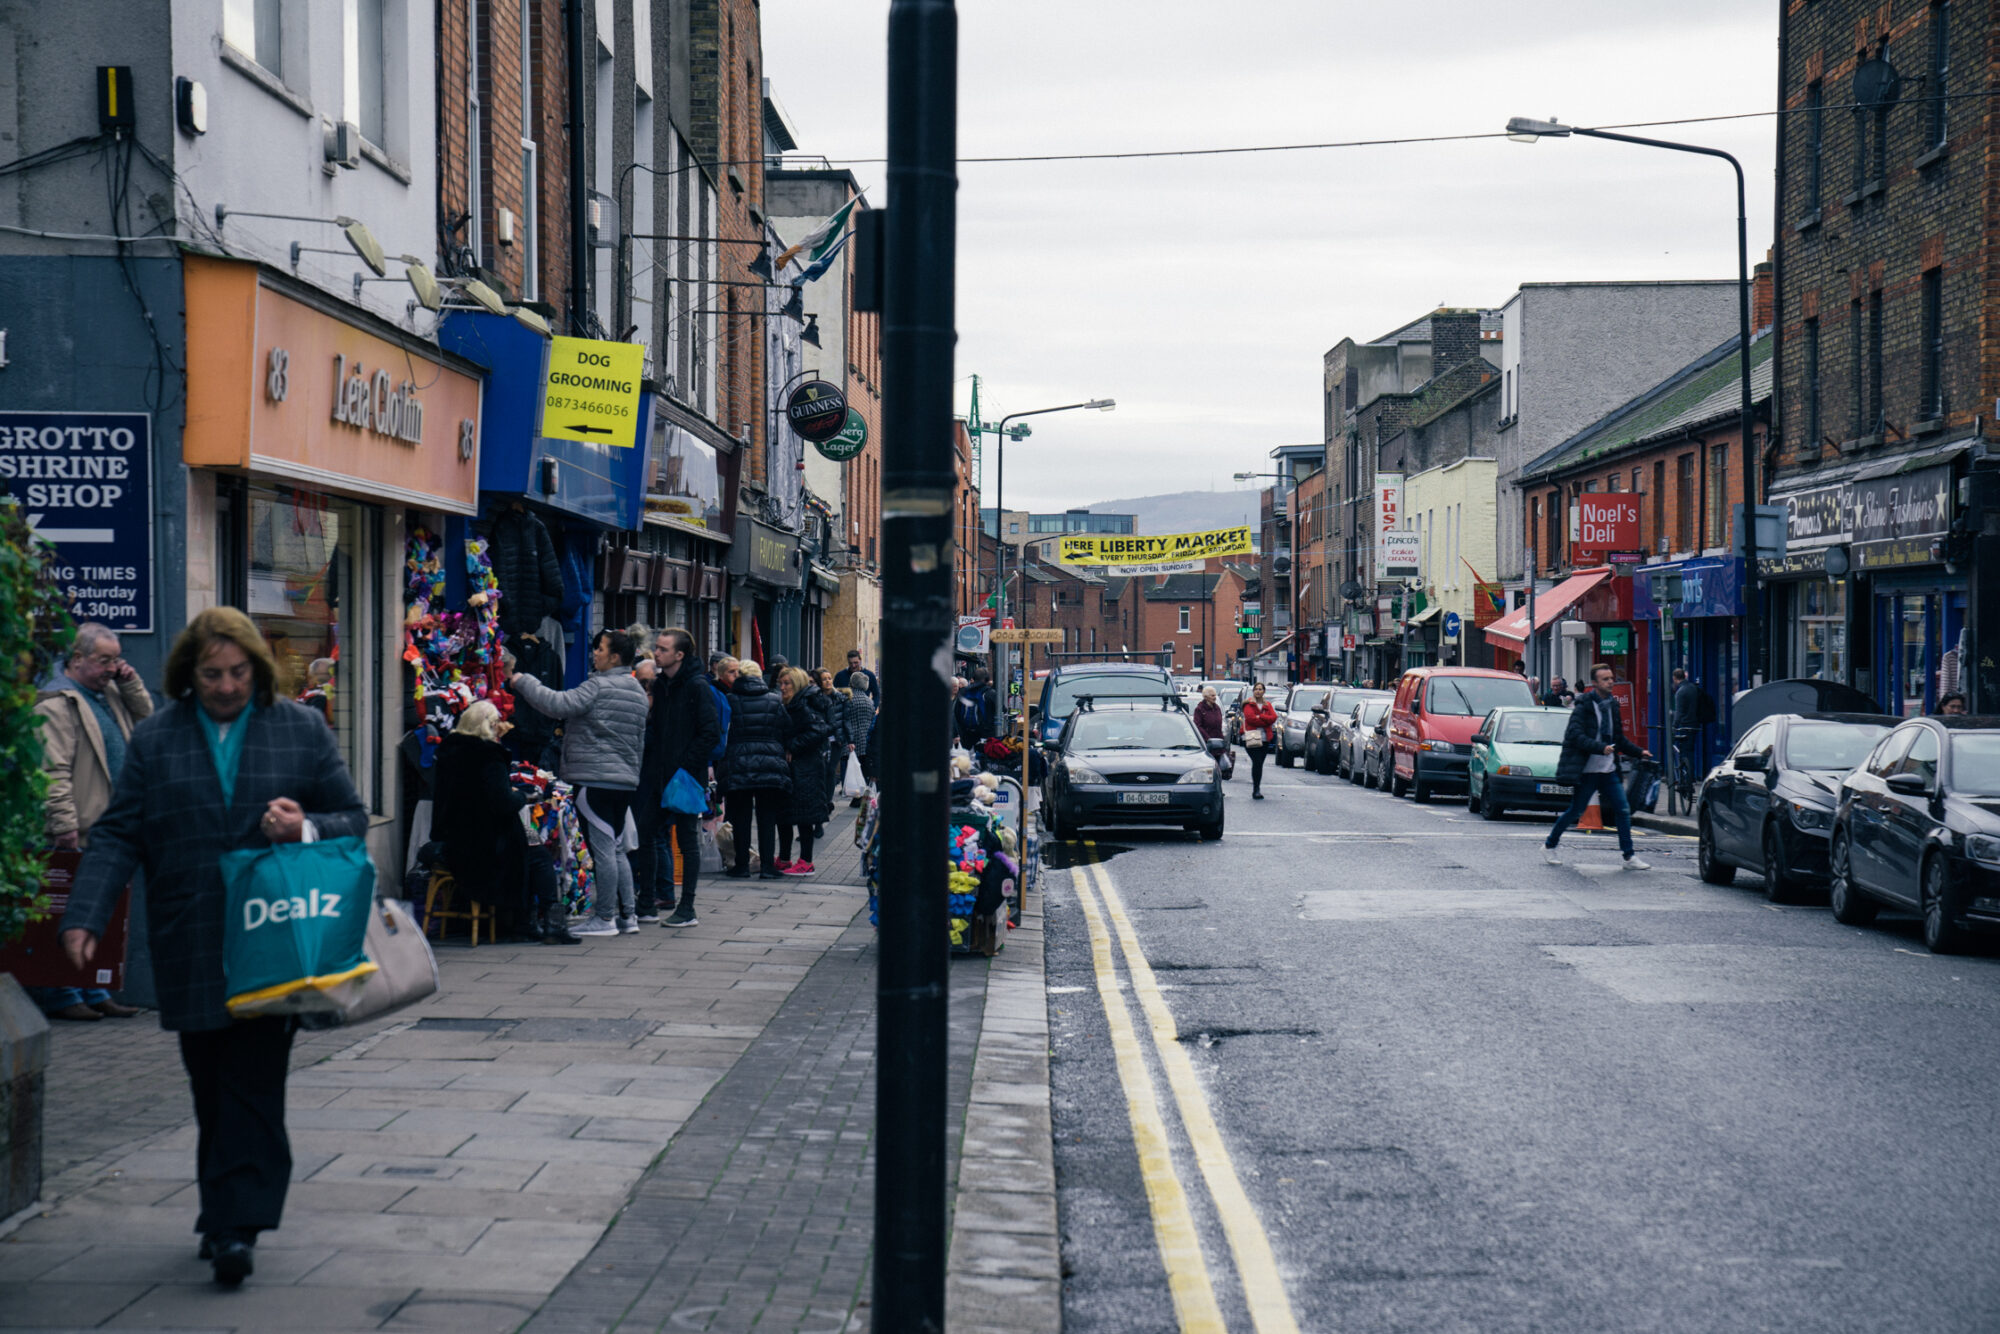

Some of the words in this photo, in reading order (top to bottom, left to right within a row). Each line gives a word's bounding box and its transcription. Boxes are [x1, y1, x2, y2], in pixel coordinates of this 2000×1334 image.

[577, 352, 611, 368] DOG
[269, 347, 289, 402] 83
[550, 372, 632, 394] GROOMING
[546, 396, 629, 418] 0873466056
[790, 398, 843, 419] GUINNESS
[823, 443, 856, 455] Lager
[0, 455, 130, 480] SHRINE
[27, 484, 123, 508] SHOP
[1583, 503, 1637, 522] Noel's
[1786, 496, 1823, 539] Famous
[1863, 490, 1888, 528] Shine
[1889, 486, 1934, 525] Fashions
[1064, 540, 1094, 551] HERE
[1100, 538, 1168, 553] LIBERTY
[1175, 529, 1247, 550] MARKET
[1583, 523, 1616, 543] Deli
[1100, 554, 1125, 562] EVERY
[1171, 549, 1197, 559] FRIDAY
[1208, 543, 1247, 555] SATURDAY
[81, 567, 137, 580] TIMES
[1161, 562, 1193, 572] SUNDAYS
[67, 585, 136, 602] Saturday
[72, 602, 137, 620] 4.30pm
[244, 888, 342, 931] Dealz
